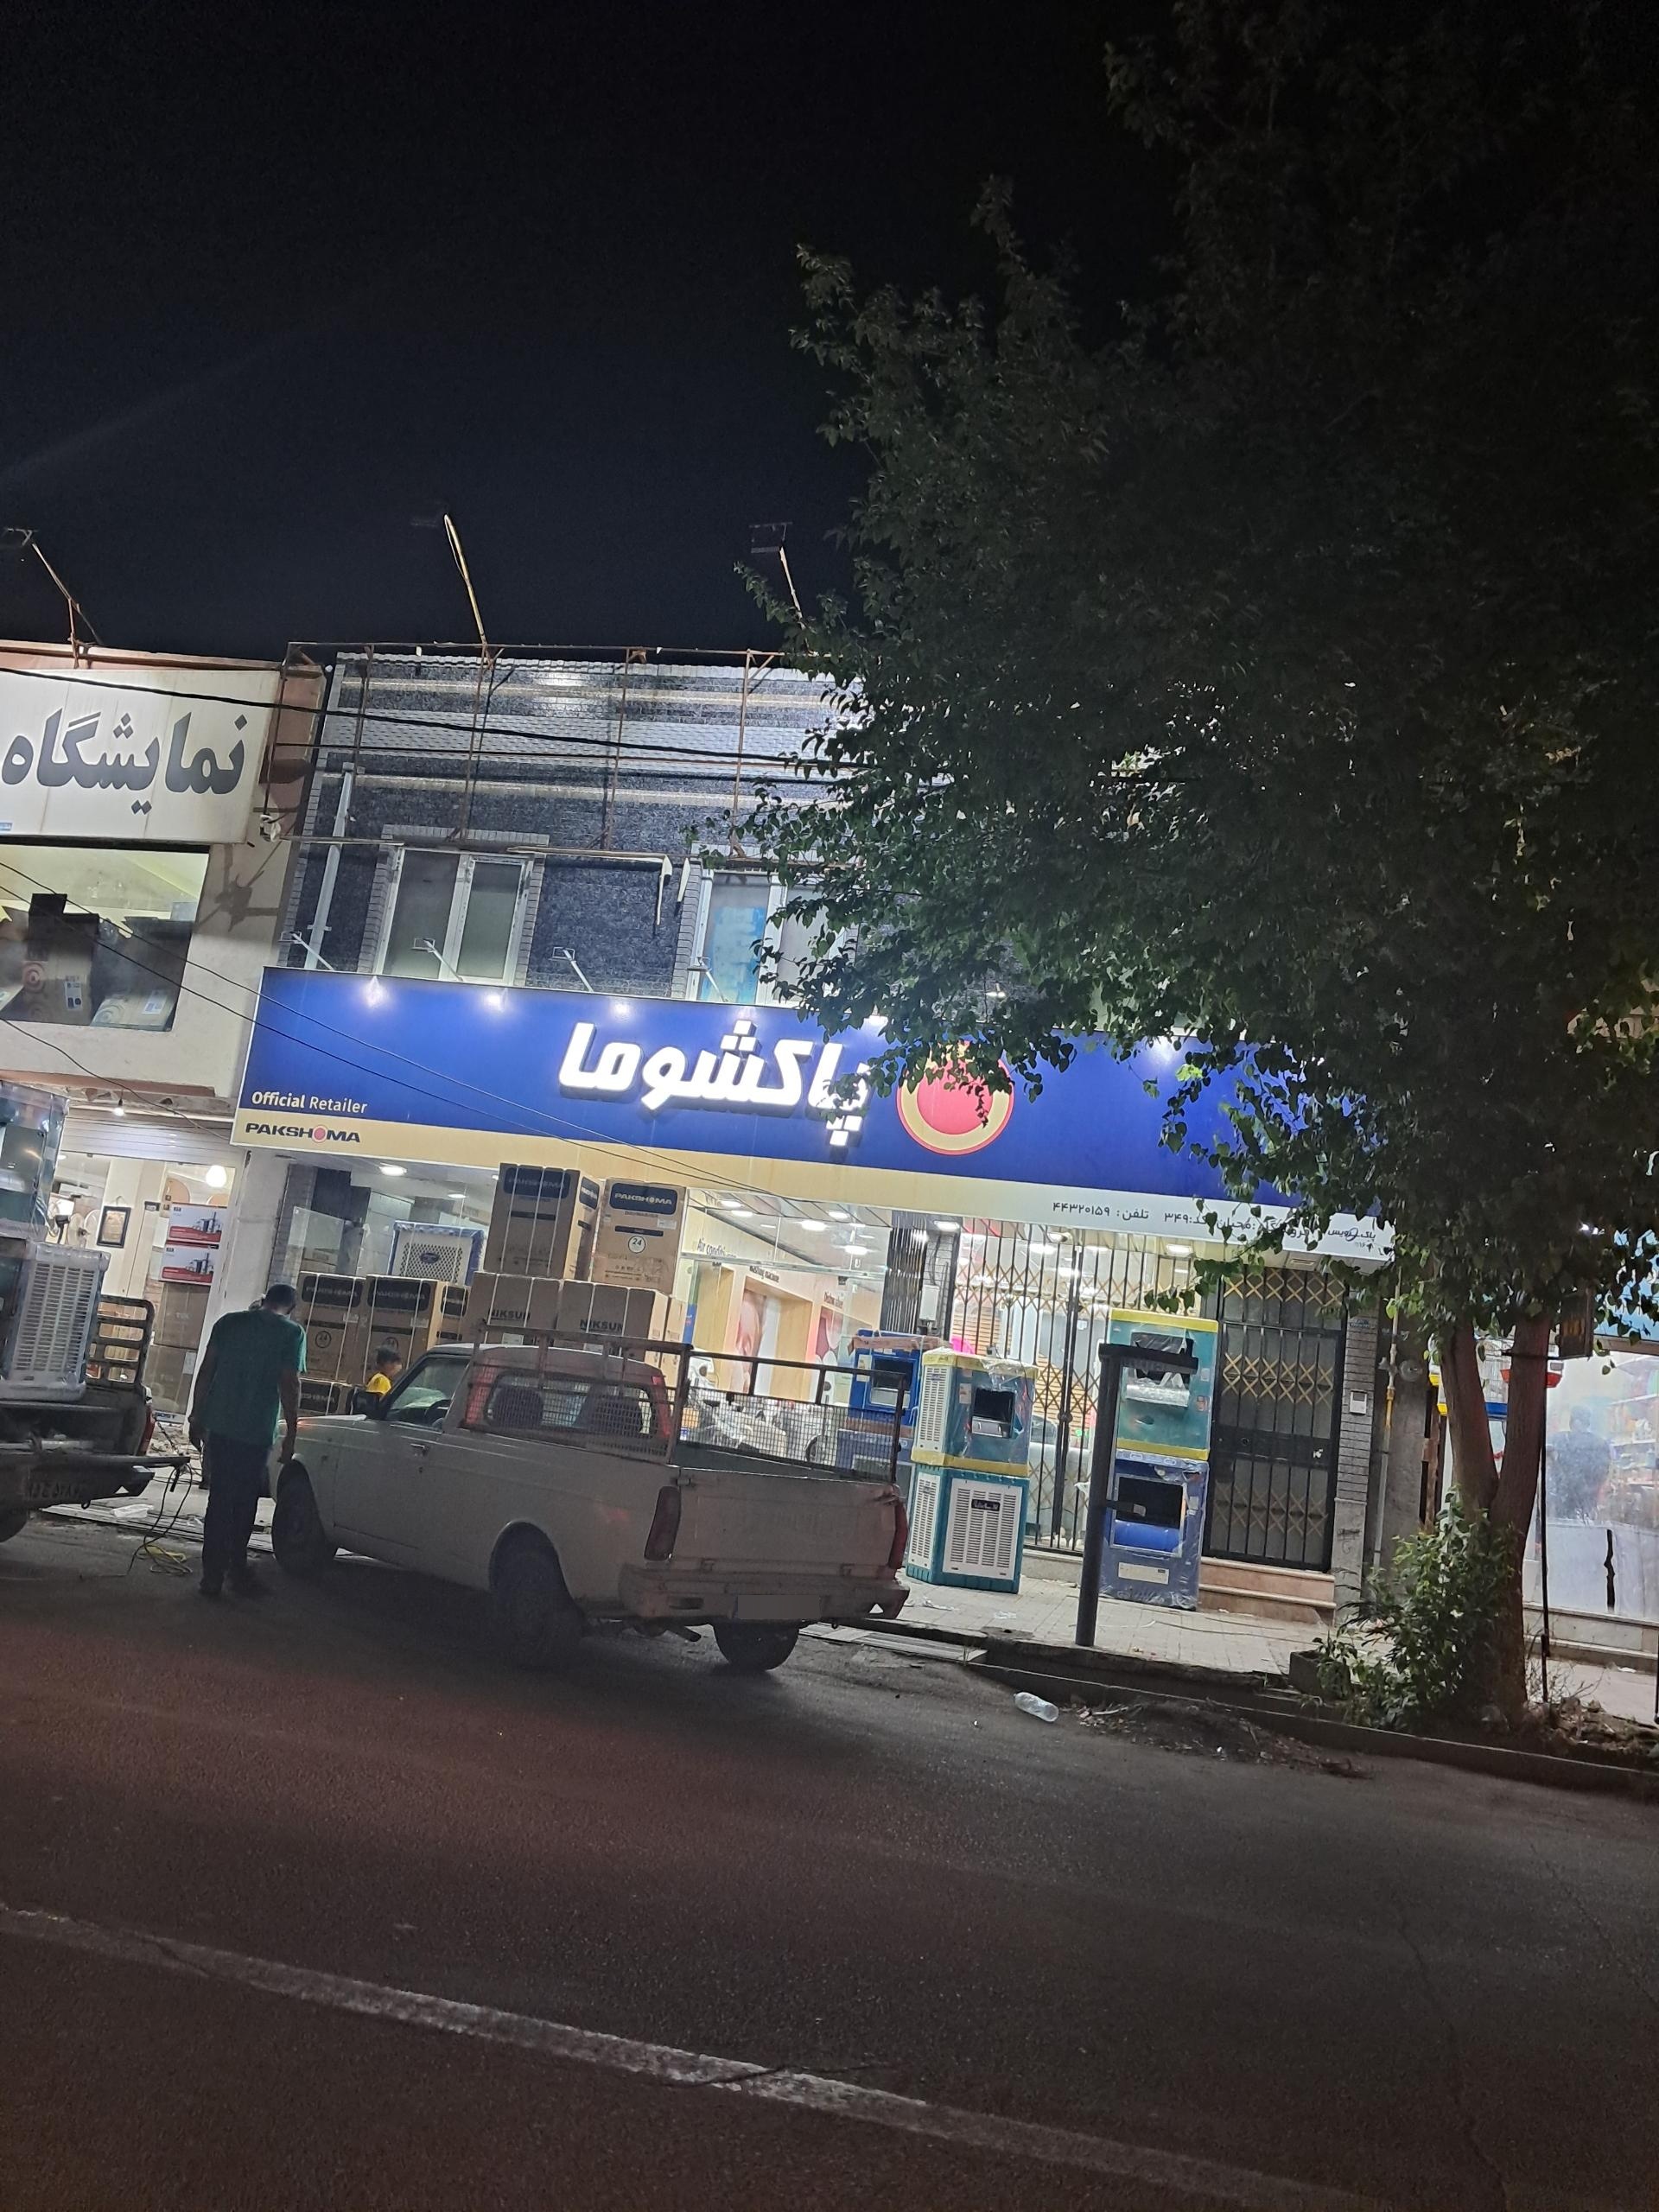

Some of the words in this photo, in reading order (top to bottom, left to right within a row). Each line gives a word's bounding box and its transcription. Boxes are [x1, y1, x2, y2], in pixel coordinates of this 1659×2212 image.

[1, 708, 248, 815] نمایشگاه
[251, 1091, 305, 1109] Official
[309, 1096, 367, 1114] Retailer
[245, 1123, 360, 1142] PAKSHOMA
[1052, 1202, 1110, 1217] ۴۴۳۲۰۱۵۹
